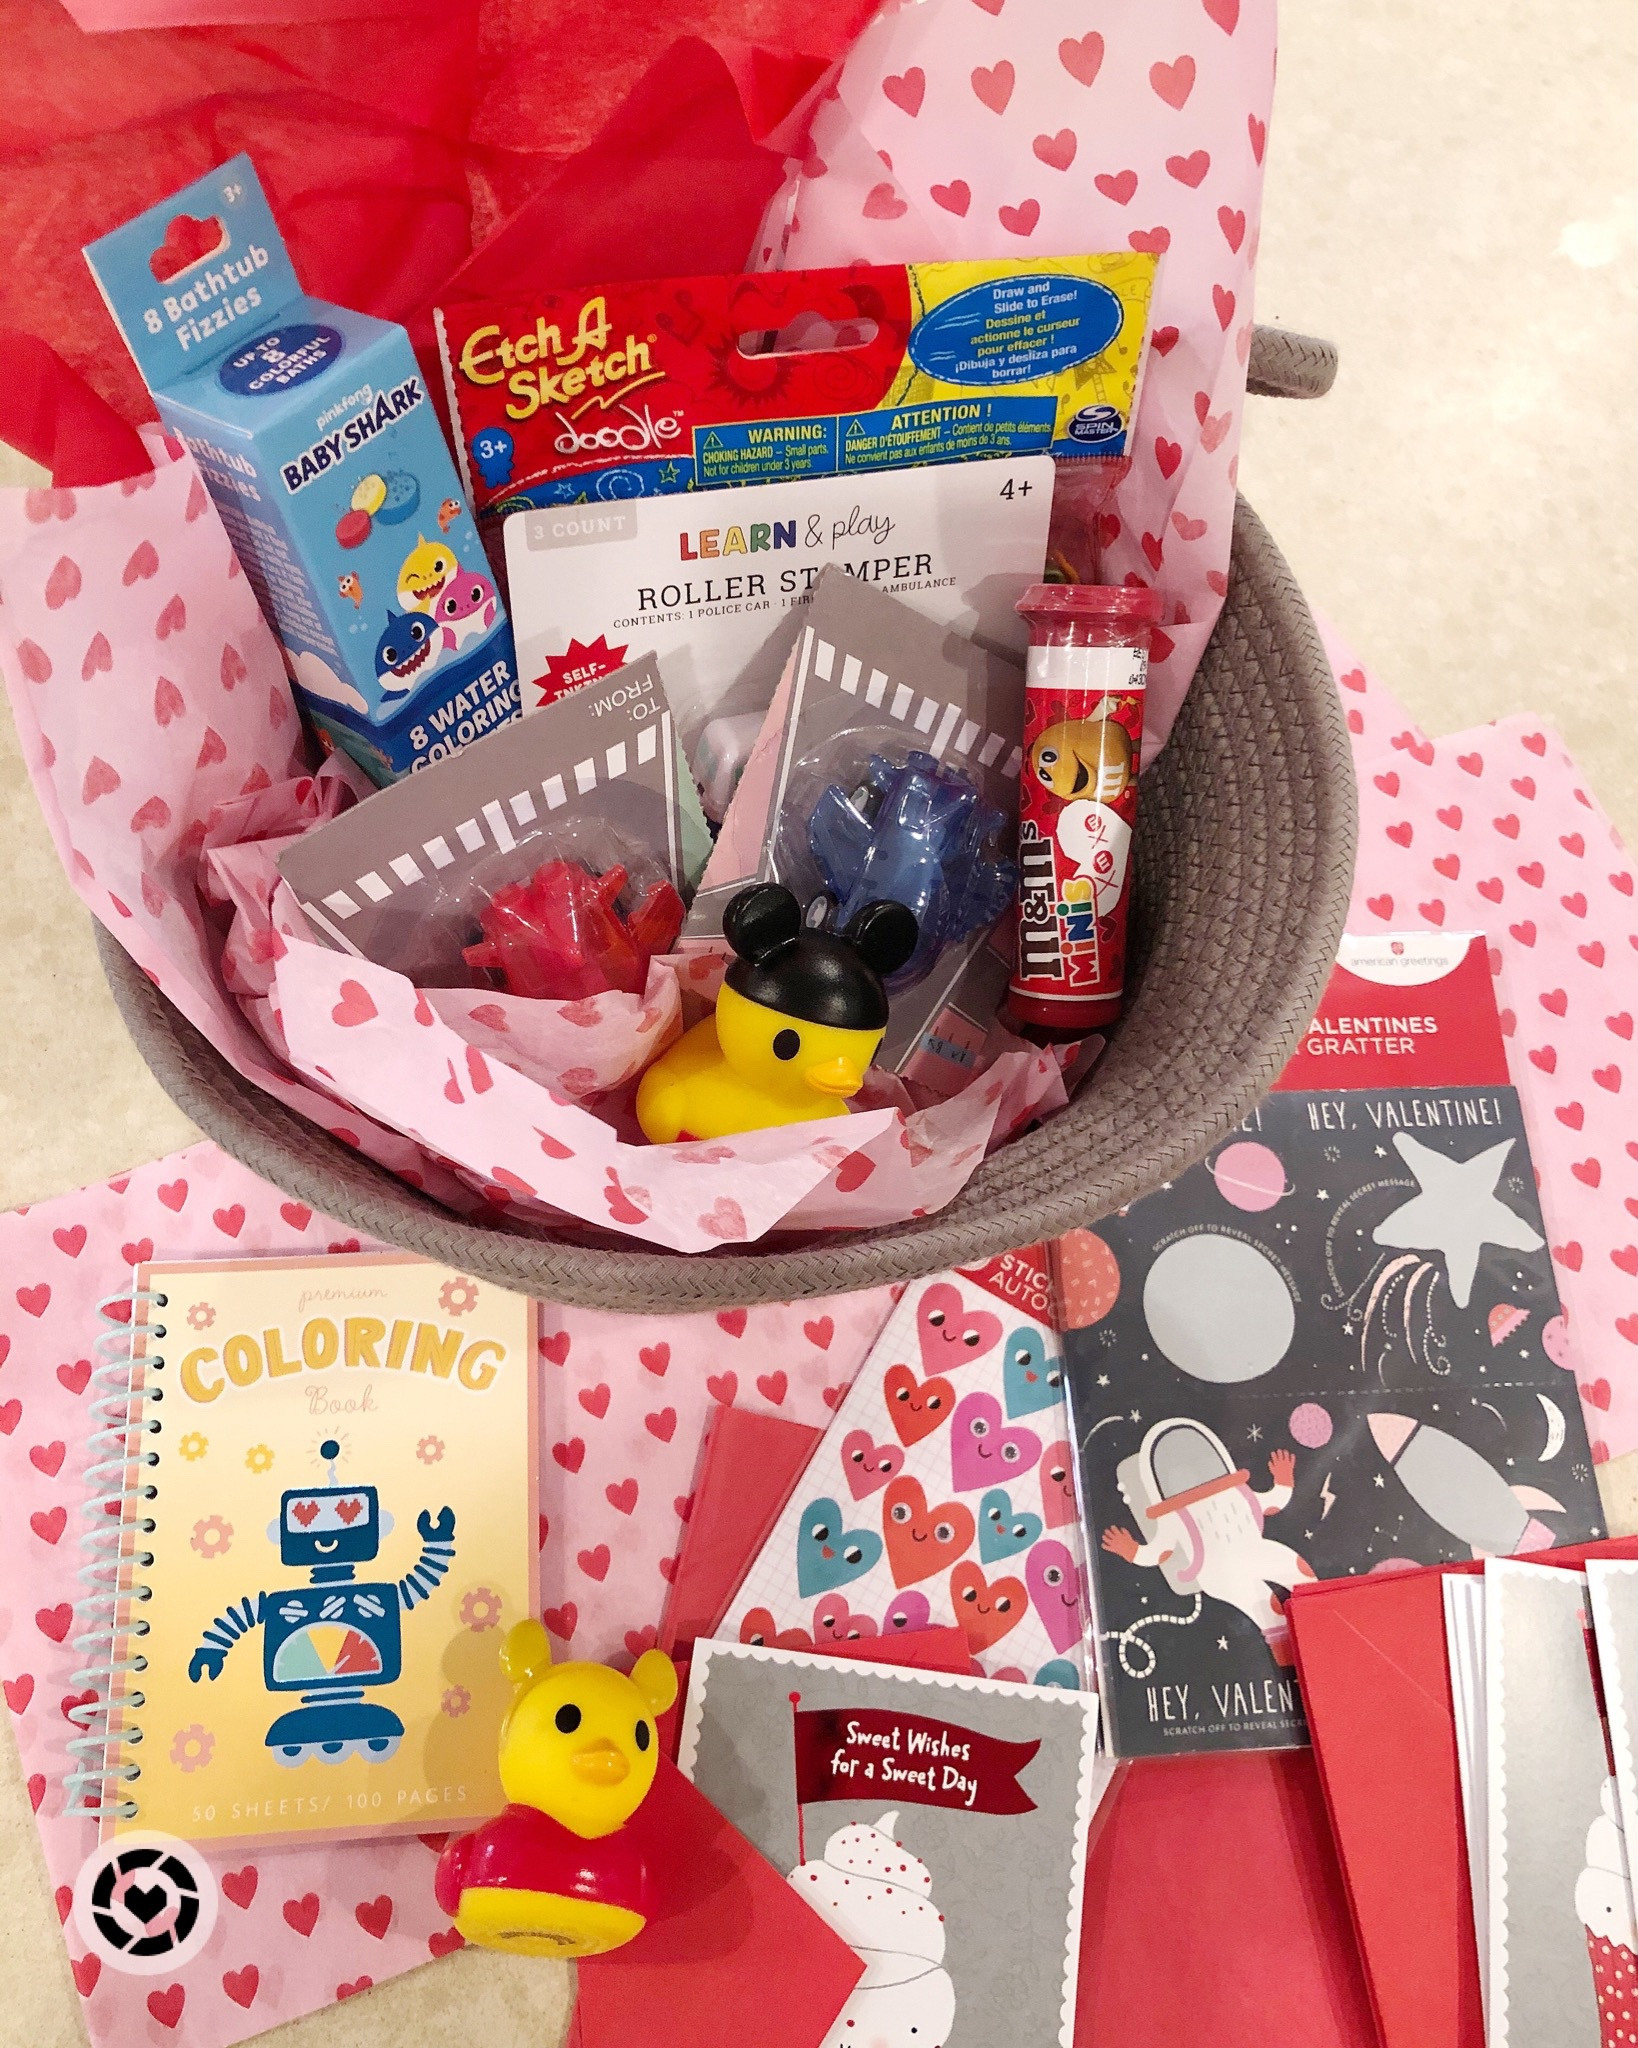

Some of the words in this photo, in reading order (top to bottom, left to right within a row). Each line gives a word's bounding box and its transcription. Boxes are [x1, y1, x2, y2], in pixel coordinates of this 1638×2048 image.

[143, 308, 163, 334] 8
[162, 244, 269, 323] Bathtub
[993, 287, 1025, 300] Draw
[1027, 281, 1050, 294] and
[994, 300, 1024, 314] Slide
[1026, 298, 1039, 309] to
[1041, 290, 1078, 306] Erase!
[175, 286, 263, 351] Fizzies
[970, 328, 1021, 345] actionne
[1023, 326, 1034, 337] le
[1036, 317, 1081, 333] curseur
[986, 311, 1032, 330] Dessine
[1034, 309, 1047, 320] et
[233, 352, 256, 369] UP
[256, 336, 281, 354] TO
[459, 316, 564, 386] Etch
[556, 296, 613, 366] A
[977, 345, 1005, 359] pour
[1006, 336, 1048, 352] effacer
[249, 335, 331, 390] COLORFUL
[261, 348, 286, 364] 8
[276, 349, 327, 385] BATHS
[955, 357, 996, 374] ¡Dibuja
[998, 356, 1006, 367] y
[1008, 350, 1049, 365] desliza
[1051, 345, 1078, 359] para
[505, 334, 652, 420] Sketch
[992, 364, 1032, 379] borrar!
[316, 383, 373, 432] pinkfong
[891, 404, 981, 430] ATTENTION
[282, 431, 342, 491] BABY
[343, 378, 422, 449] SHARK
[748, 424, 827, 444] WARNING:
[845, 436, 878, 452] DANGER
[952, 421, 983, 437] Contient
[983, 420, 994, 433] de
[994, 419, 1017, 435] petits
[1074, 427, 1117, 436] MASTER
[1075, 421, 1114, 430] SPIN
[479, 439, 507, 459] 3+
[702, 448, 739, 465] CHOKING
[740, 446, 773, 461] HAZARD
[785, 444, 807, 457] Small
[844, 453, 856, 465] Ne
[857, 447, 888, 464] convient
[889, 448, 903, 462] pas
[904, 446, 918, 459] aux
[918, 440, 945, 456] enfants
[946, 438, 956, 451] de
[956, 436, 978, 449] moins
[978, 435, 989, 447] de
[989, 434, 996, 445] 3
[703, 465, 717, 477] Not
[718, 463, 730, 475] for
[730, 460, 761, 475] children
[761, 459, 783, 471] under
[784, 458, 790, 470] 3
[999, 478, 1033, 500] 4+
[533, 525, 544, 540] 3
[552, 515, 626, 537] COUNT
[679, 519, 797, 561] LEARN
[804, 514, 823, 548] &
[832, 505, 896, 549] play
[638, 574, 766, 611] ROLLER
[780, 554, 932, 592] STMPER
[613, 612, 685, 628] CONTENTS:
[689, 610, 694, 619] 1
[698, 604, 742, 618] POLICE
[745, 600, 771, 612] CAR
[881, 577, 957, 594] AMBULANCE
[562, 662, 607, 685] SELF-
[409, 725, 429, 750] 8
[428, 660, 511, 734] WATER
[588, 673, 655, 717] FROM:
[627, 697, 661, 721] TO:
[1350, 956, 1398, 967] american
[1399, 955, 1449, 968] greetings
[1307, 1016, 1438, 1035] ALENTINES
[1306, 1037, 1416, 1056] GRATTER
[1307, 1101, 1358, 1131] HEY,
[1366, 1098, 1502, 1130] VALENTINE!
[1377, 1178, 1415, 1188] MESSAGE
[1152, 1228, 1186, 1252] SCRATCH
[1187, 1223, 1204, 1234] OFF
[1206, 1224, 1218, 1233] TO
[1220, 1224, 1251, 1243] REVEAL
[1254, 1239, 1282, 1266] SECRET
[299, 1286, 388, 1313] premium
[180, 1317, 507, 1404] COLORING
[304, 1384, 379, 1415] Book
[1146, 1684, 1200, 1722] HEY,
[1211, 1679, 1298, 1718] VALEN
[846, 1720, 901, 1751] Sweet
[907, 1728, 971, 1761] Wishes
[1163, 1726, 1206, 1737] SCRATCH
[1208, 1724, 1226, 1732] OFF
[1229, 1723, 1241, 1731] TO
[1243, 1721, 1277, 1730] REVEAL
[830, 1748, 860, 1778] for
[864, 1762, 875, 1779] a
[881, 1757, 937, 1792] Sweet
[941, 1765, 978, 1807] Day
[192, 1806, 216, 1823] 50
[231, 1794, 330, 1820] SHEETS/
[347, 1791, 383, 1809] 100
[397, 1785, 467, 1805] PAGES
